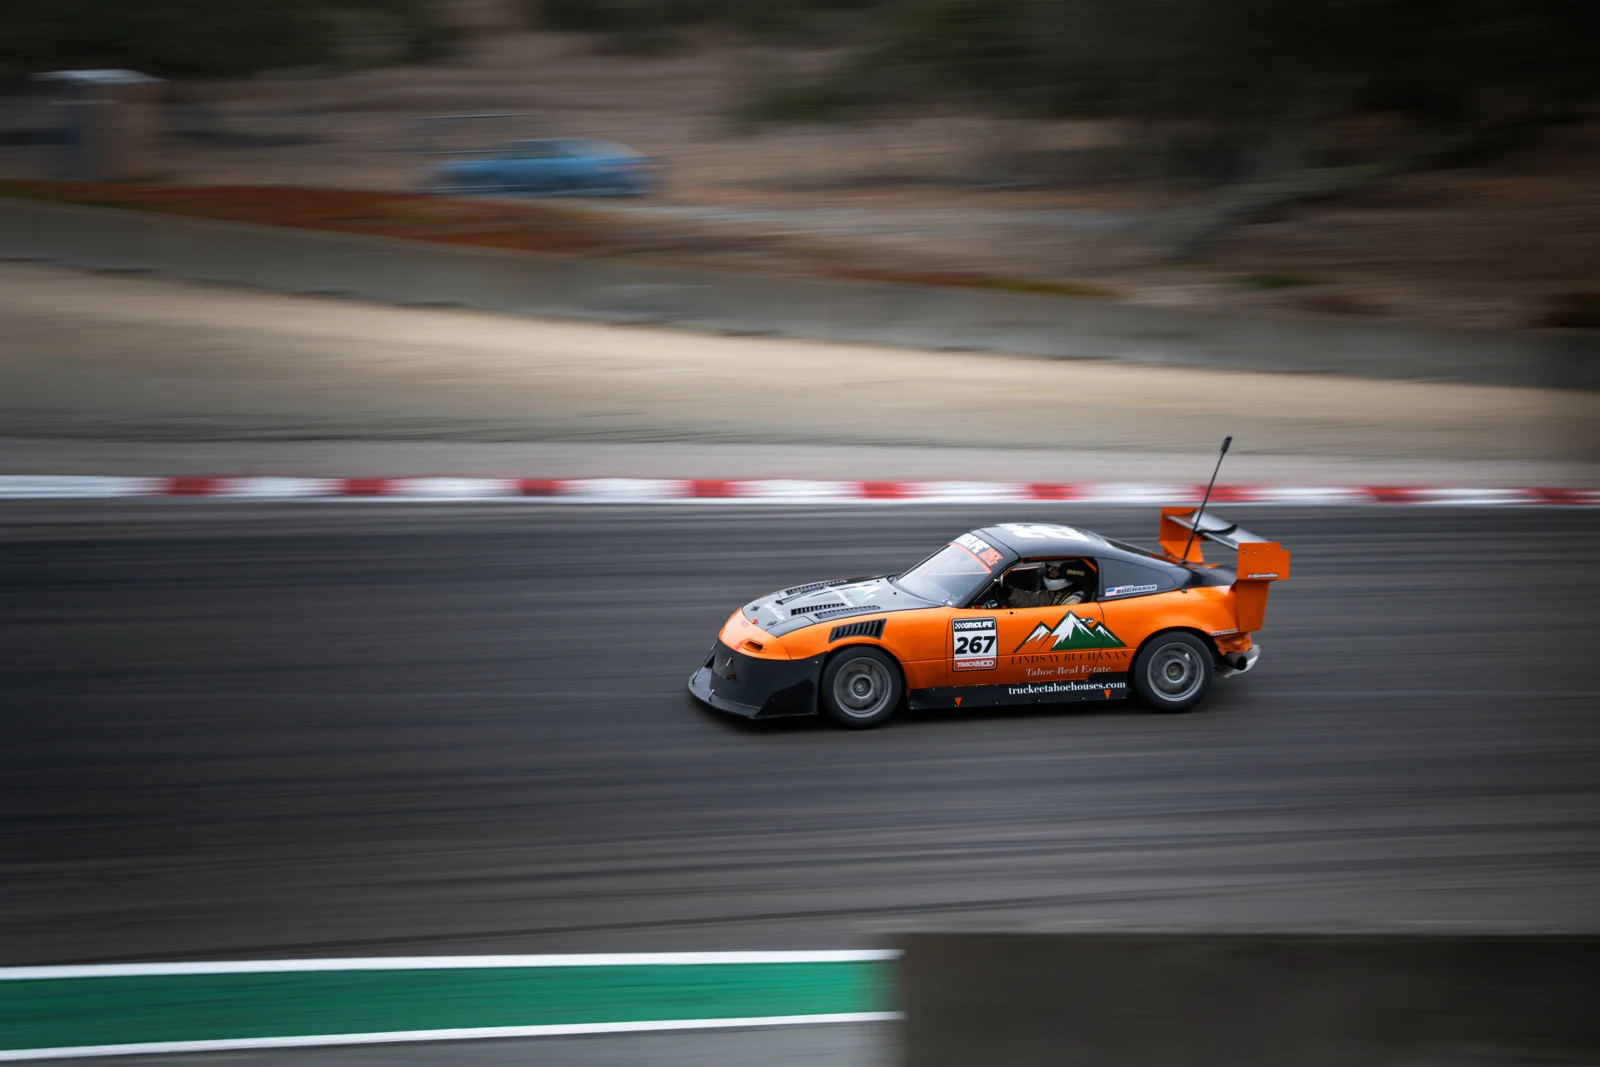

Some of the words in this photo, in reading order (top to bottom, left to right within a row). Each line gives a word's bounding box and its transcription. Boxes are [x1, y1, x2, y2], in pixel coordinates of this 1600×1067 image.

[1116, 585, 1156, 594] BUCHANAN
[963, 621, 994, 629] GRIDLIFE
[955, 635, 996, 654] 267
[956, 659, 994, 668] TRACKMOD
[1011, 653, 1059, 665] LINDSAY
[1064, 651, 1128, 662] BUCHANAN
[1025, 667, 1055, 676] Tahoe
[1057, 665, 1078, 675] Real
[1081, 665, 1111, 673] Estate
[1008, 681, 1126, 695] truckeetahoehouses.com
